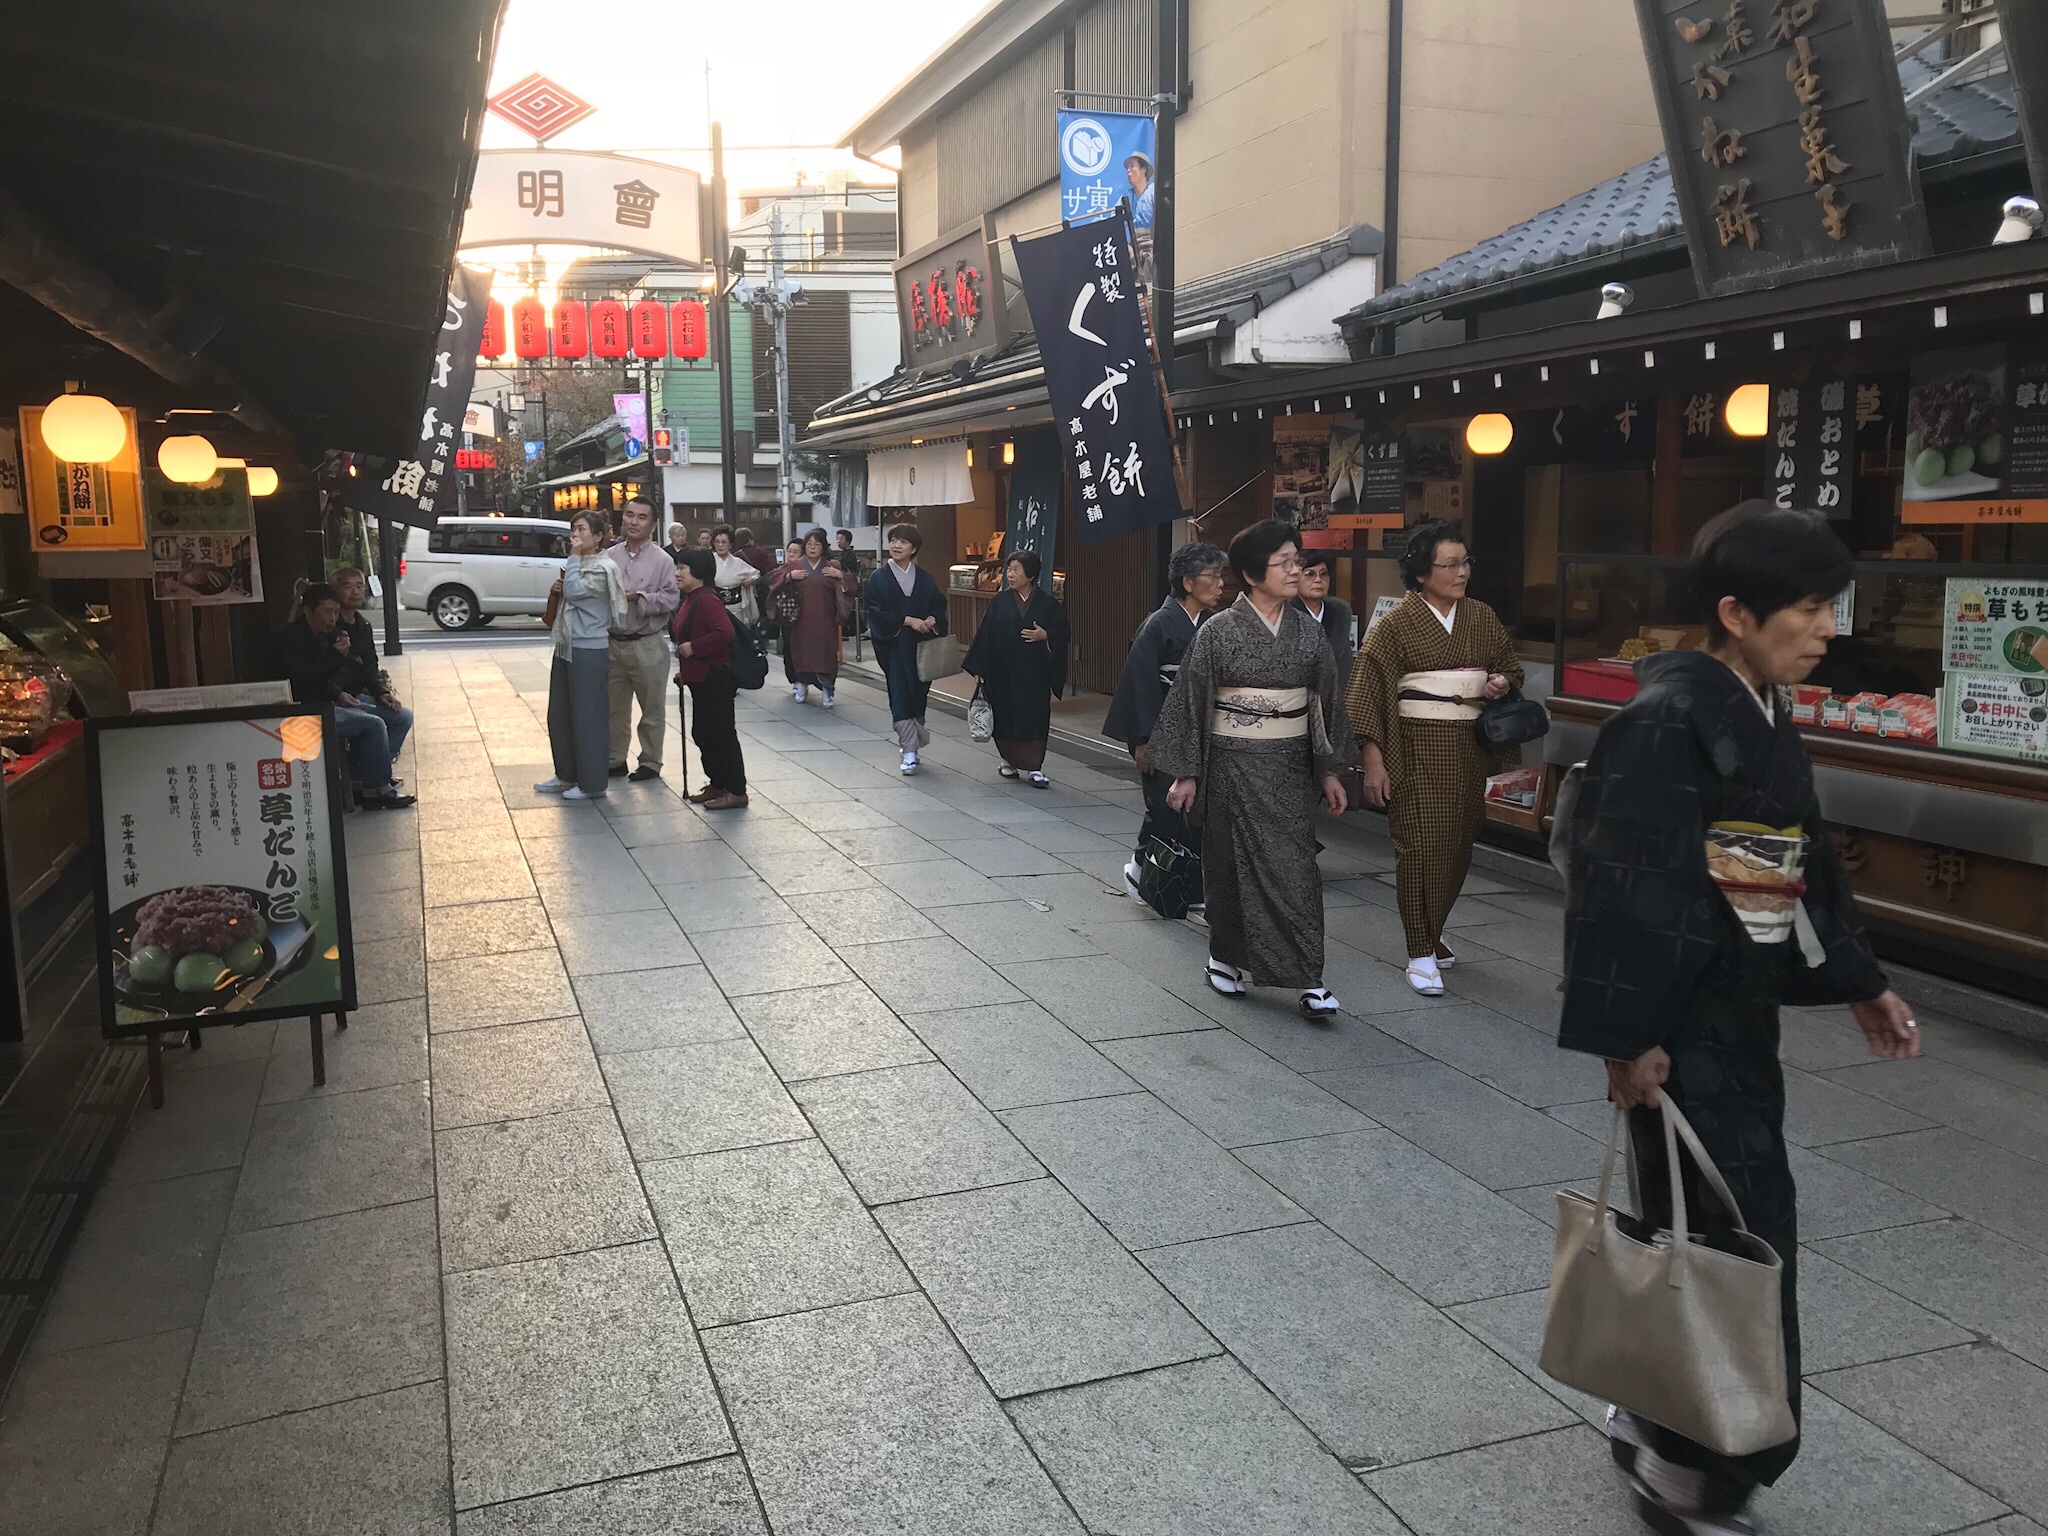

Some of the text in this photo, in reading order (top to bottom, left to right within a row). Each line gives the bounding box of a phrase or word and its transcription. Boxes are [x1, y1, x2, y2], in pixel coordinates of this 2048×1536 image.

[1086, 178, 1114, 221] 寅
[1092, 236, 1125, 304] 特製
[1067, 282, 1147, 498] くず餅
[1551, 391, 1716, 446] くず餅
[1817, 379, 1846, 507] 磯おとめ
[1774, 387, 1799, 509] 焼だんご
[1963, 602, 1982, 614] 特撰
[1950, 652, 1983, 662] 本日中に
[1965, 714, 2040, 731] お召し上がり下さい
[1978, 701, 2028, 719] 本日中に
[166, 765, 182, 819] 味わう贅沢。
[264, 763, 279, 786] 名物
[277, 762, 292, 785] 柴又
[186, 763, 204, 858] 粒あんの上品な甘みで
[226, 761, 242, 846] 極上のもちもち感と
[258, 792, 302, 921] 草だんご
